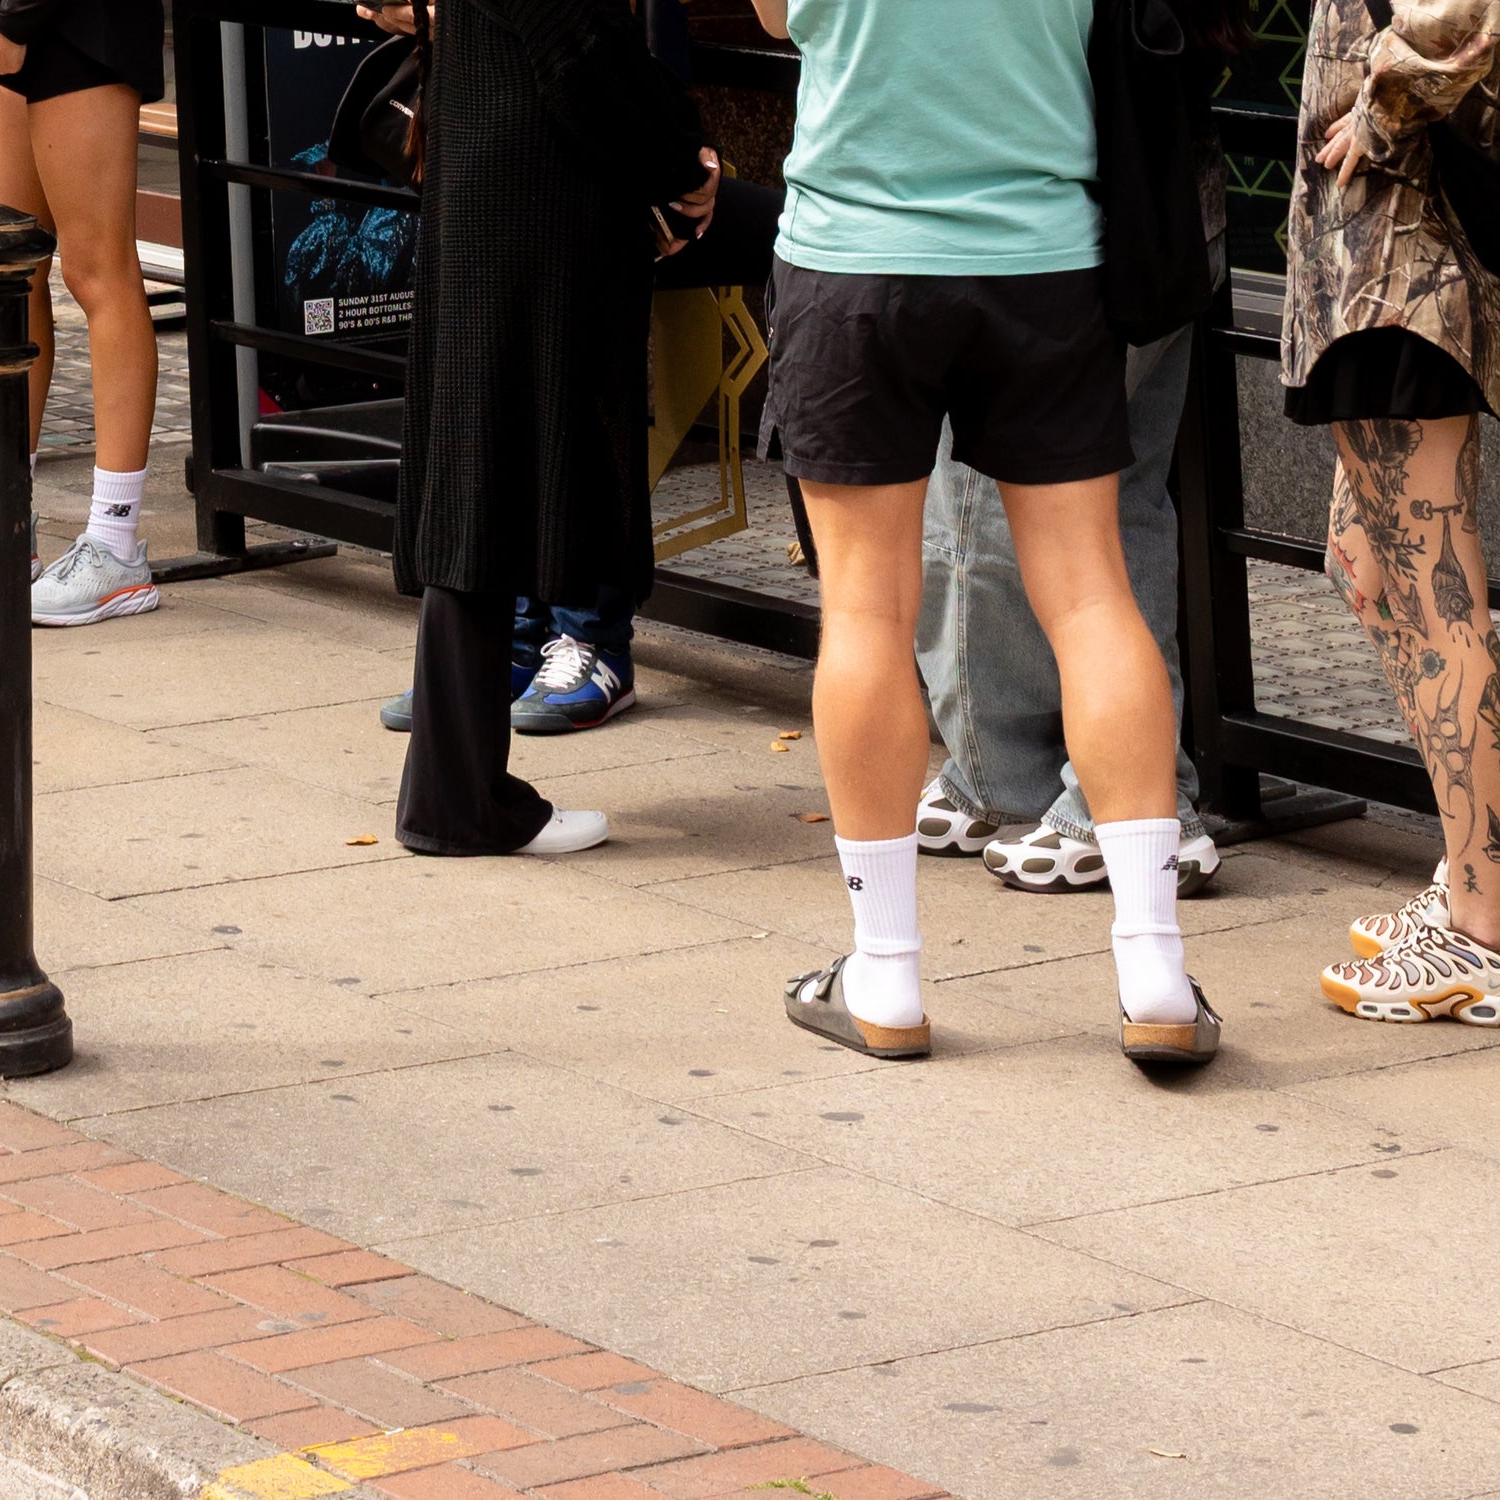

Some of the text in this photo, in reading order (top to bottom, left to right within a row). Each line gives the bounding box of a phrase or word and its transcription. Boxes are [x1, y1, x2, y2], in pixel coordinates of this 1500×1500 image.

[338, 295, 369, 307] SUNDAY
[371, 293, 388, 304] 31ST
[338, 310, 344, 318] 2
[345, 307, 367, 317] HOUR
[338, 320, 355, 330] 90'S
[357, 319, 362, 327] &
[364, 317, 380, 326] 00'S
[381, 315, 396, 324] R&B
